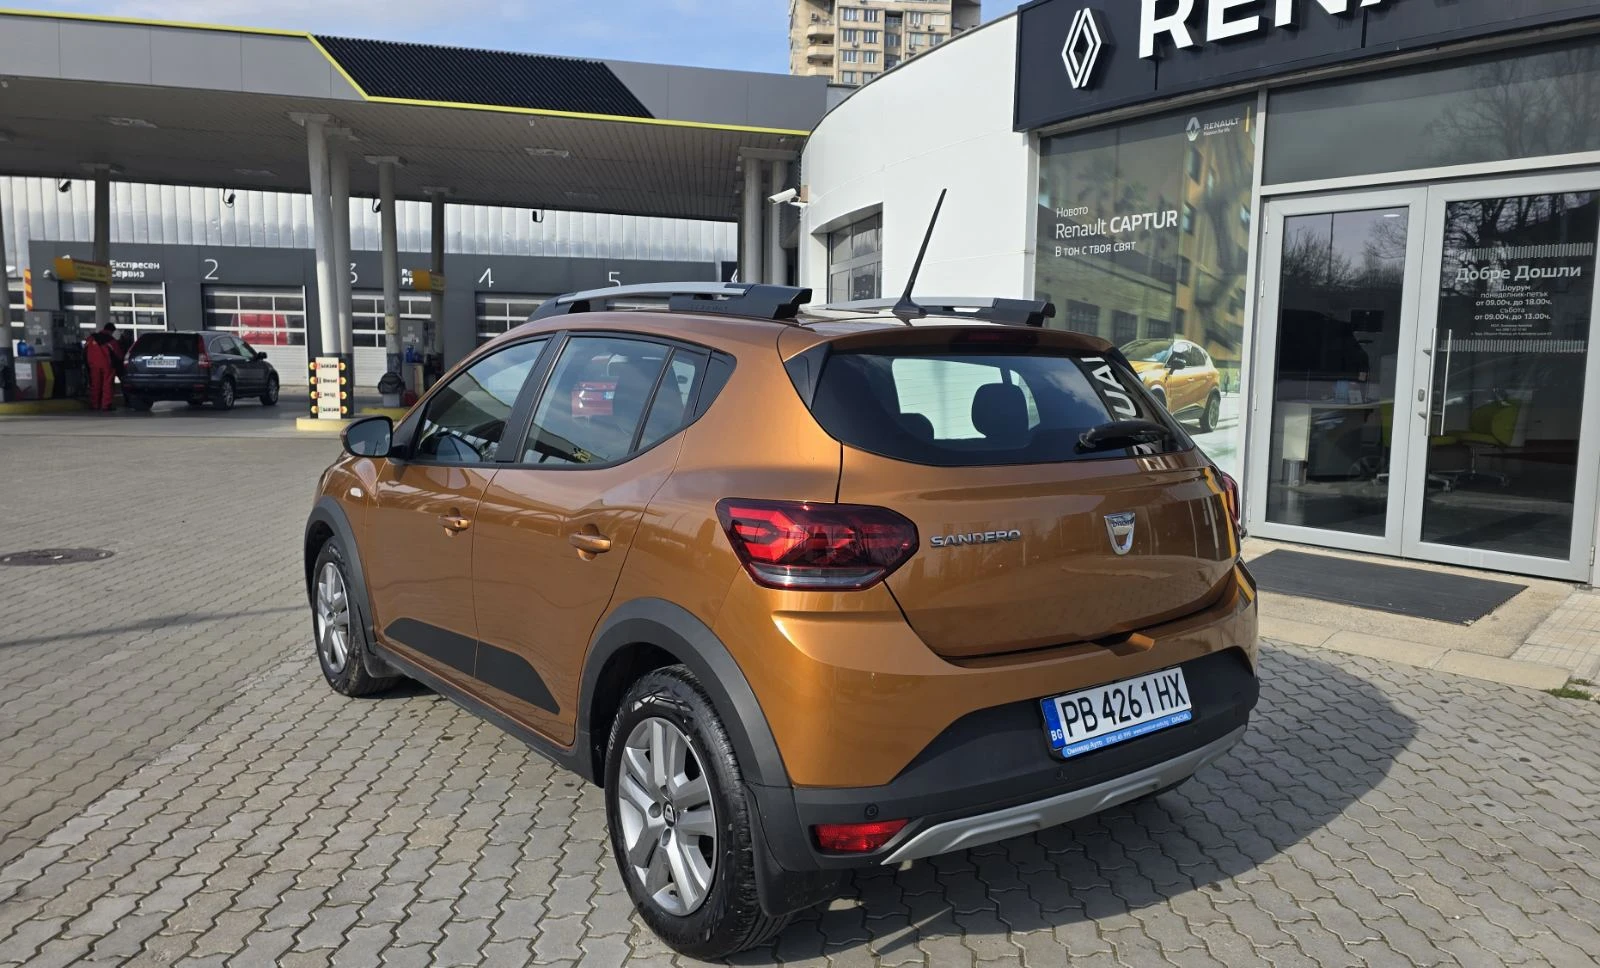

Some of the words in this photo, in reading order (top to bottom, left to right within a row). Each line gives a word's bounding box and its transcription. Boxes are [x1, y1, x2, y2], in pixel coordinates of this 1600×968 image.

[1203, 118, 1239, 130] RENAULT
[1056, 206, 1089, 218] Новото
[1056, 217, 1106, 239] Renault
[1110, 209, 1178, 234] CAPTUR
[1055, 246, 1062, 257] В
[1064, 247, 1080, 255] тон
[1082, 246, 1087, 255] с
[1089, 244, 1112, 254] твоя
[1113, 241, 1136, 253] свят
[110, 260, 160, 270] Експресен
[204, 259, 219, 280] 2
[348, 263, 358, 283] 3
[479, 268, 494, 287] 4
[608, 271, 621, 287] 5
[1455, 266, 1511, 283] Добре
[1514, 265, 1582, 281] Дошли
[1500, 284, 1531, 293] Шоурум
[1500, 306, 1525, 314] събота
[930, 529, 1022, 548] SANDERO
[1060, 696, 1098, 737] PB
[1102, 681, 1154, 725] 4261
[1154, 672, 1187, 711] HX
[1171, 714, 1190, 724] DACIA
[1051, 729, 1063, 741] BG
